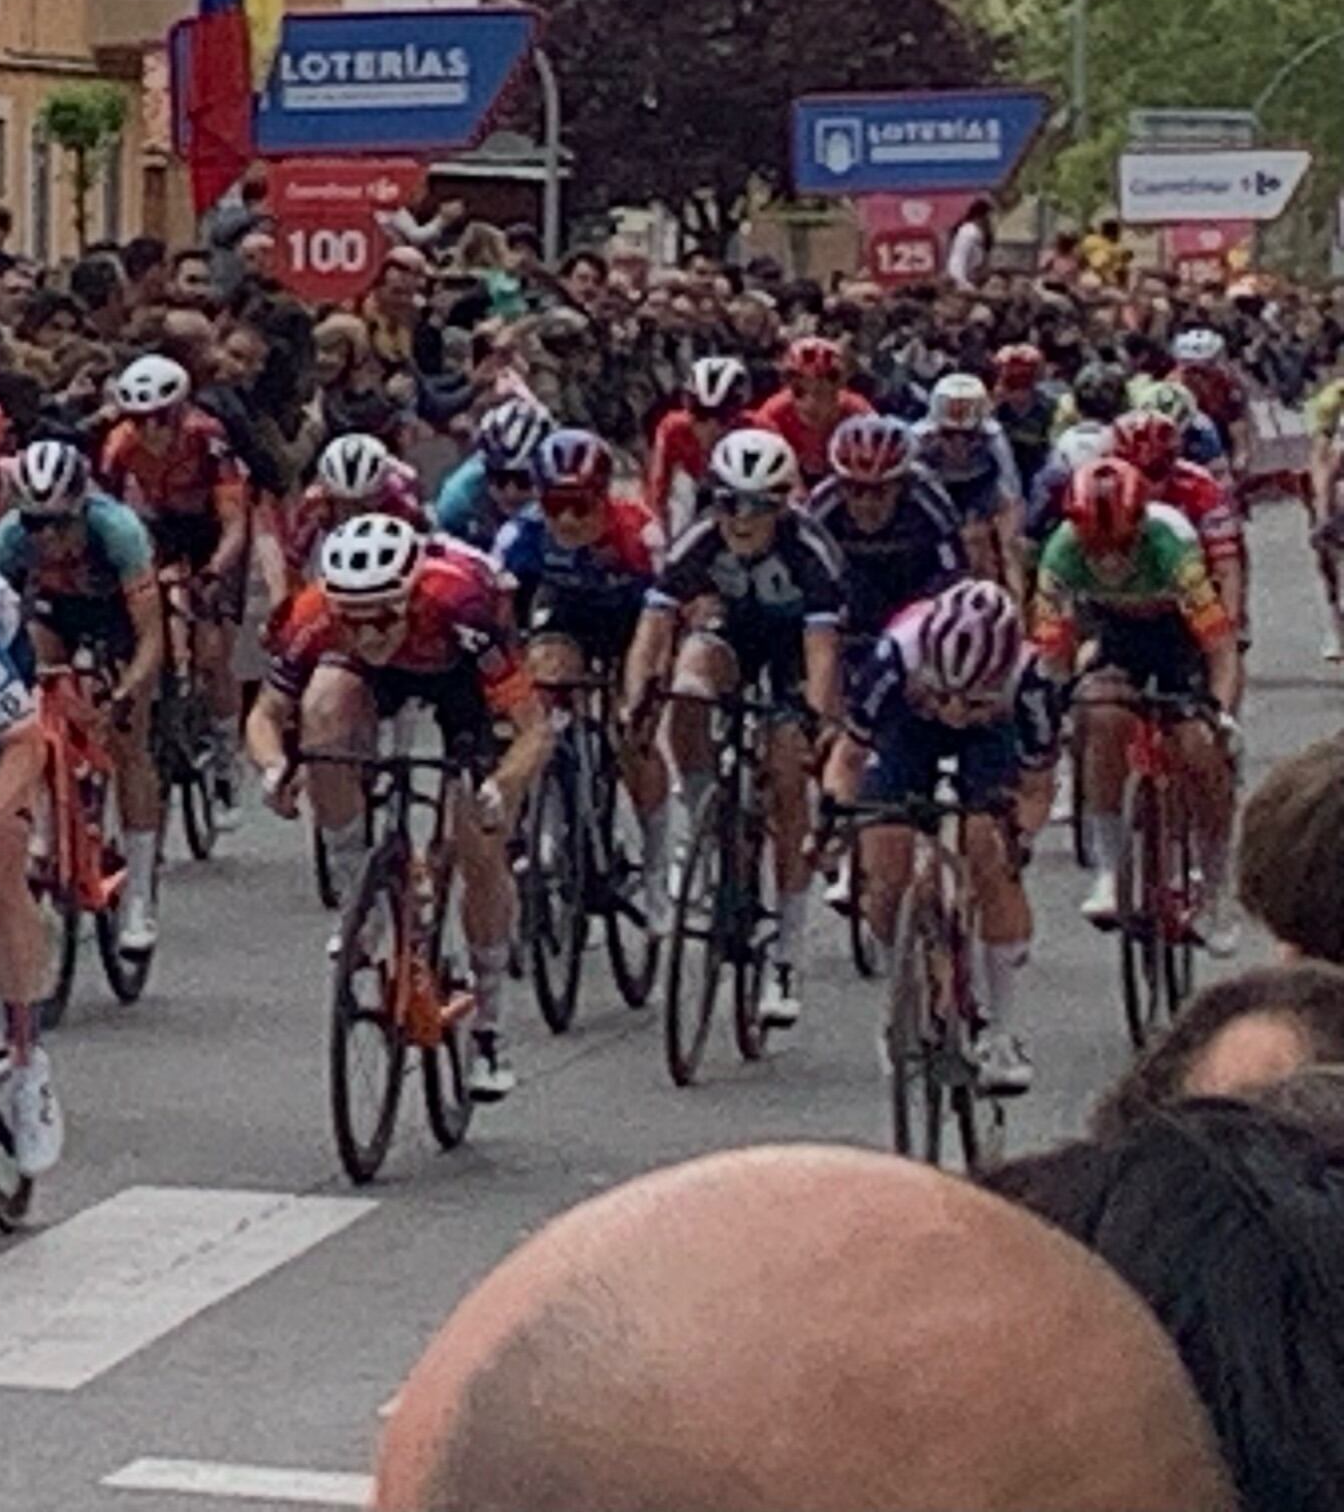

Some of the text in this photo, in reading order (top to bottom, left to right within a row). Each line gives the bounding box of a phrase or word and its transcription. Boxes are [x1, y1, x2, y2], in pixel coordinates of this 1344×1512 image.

[279, 44, 470, 82] LOTERÍAS
[867, 118, 1002, 145] LOTERÍAS
[286, 228, 369, 274] 100
[875, 241, 936, 275] 125
